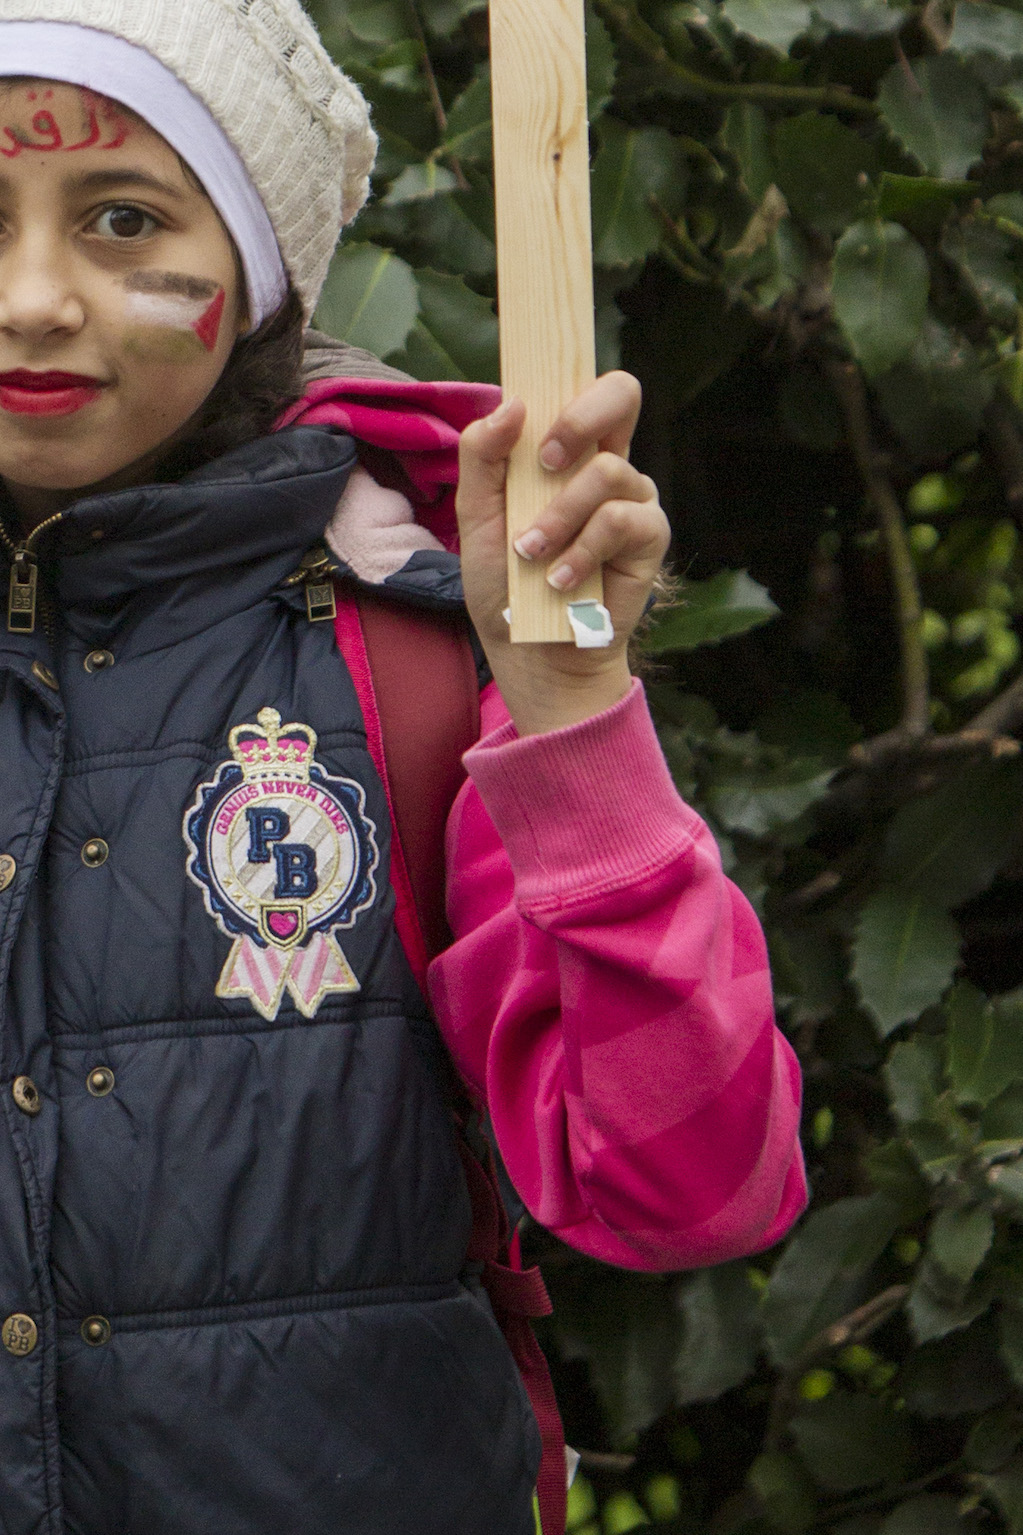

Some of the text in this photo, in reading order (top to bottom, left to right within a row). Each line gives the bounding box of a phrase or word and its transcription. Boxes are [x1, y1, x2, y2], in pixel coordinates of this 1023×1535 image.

[216, 781, 349, 836] GENIUS NEVER DIES
